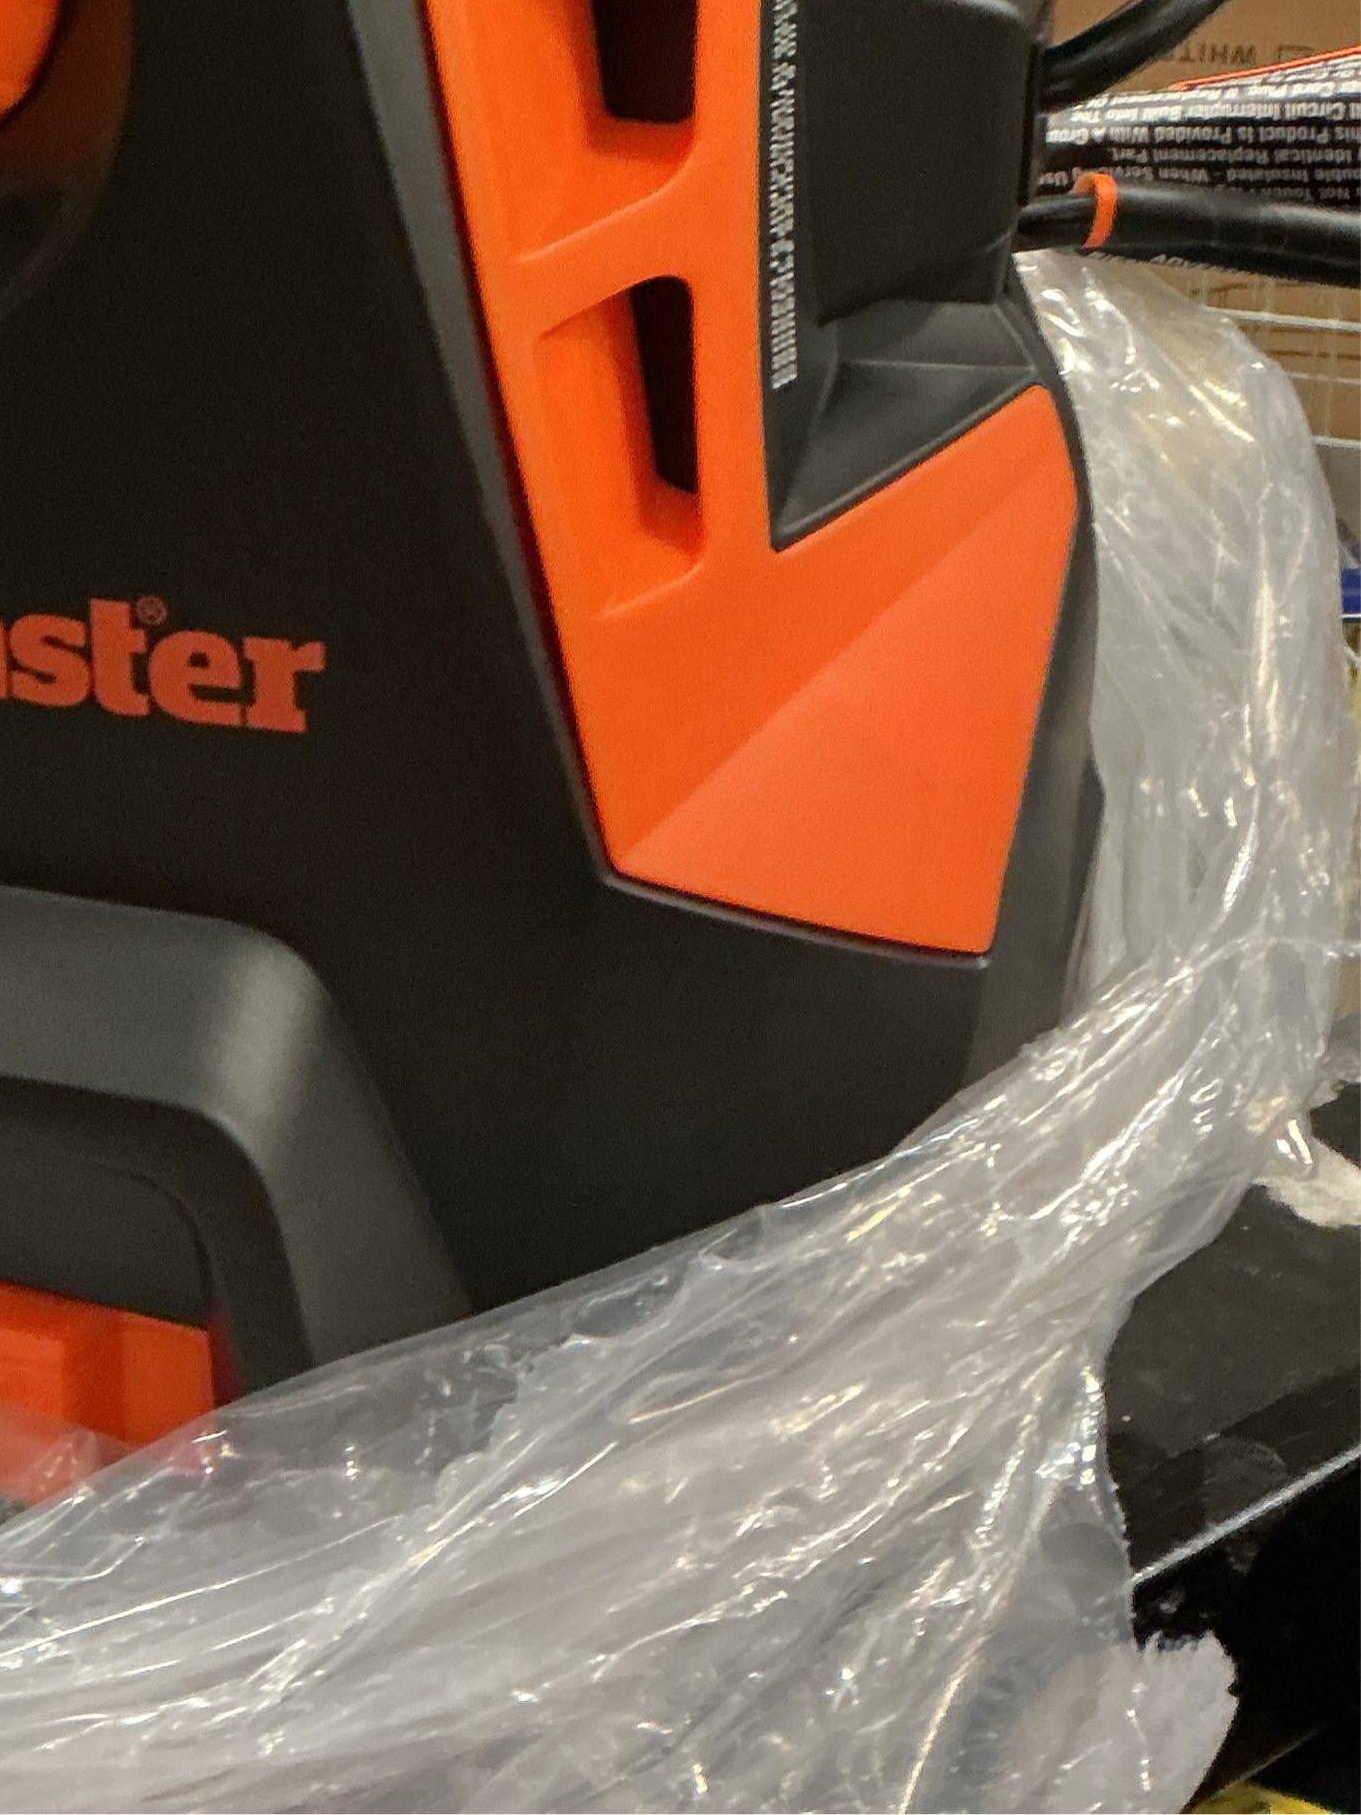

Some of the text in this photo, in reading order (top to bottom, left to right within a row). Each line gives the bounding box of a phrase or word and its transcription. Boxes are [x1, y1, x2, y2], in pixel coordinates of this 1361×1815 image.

[1169, 42, 1256, 66] WHIT
[1283, 102, 1345, 121] Circuit
[1045, 128, 1089, 145] Grou
[1109, 126, 1149, 144] With
[1153, 126, 1232, 144] Provided
[1259, 126, 1329, 144] Product
[1334, 126, 1361, 144] his
[1153, 146, 1269, 164] Replacement
[1274, 148, 1352, 164] Identical
[1314, 168, 1361, 182] ouble
